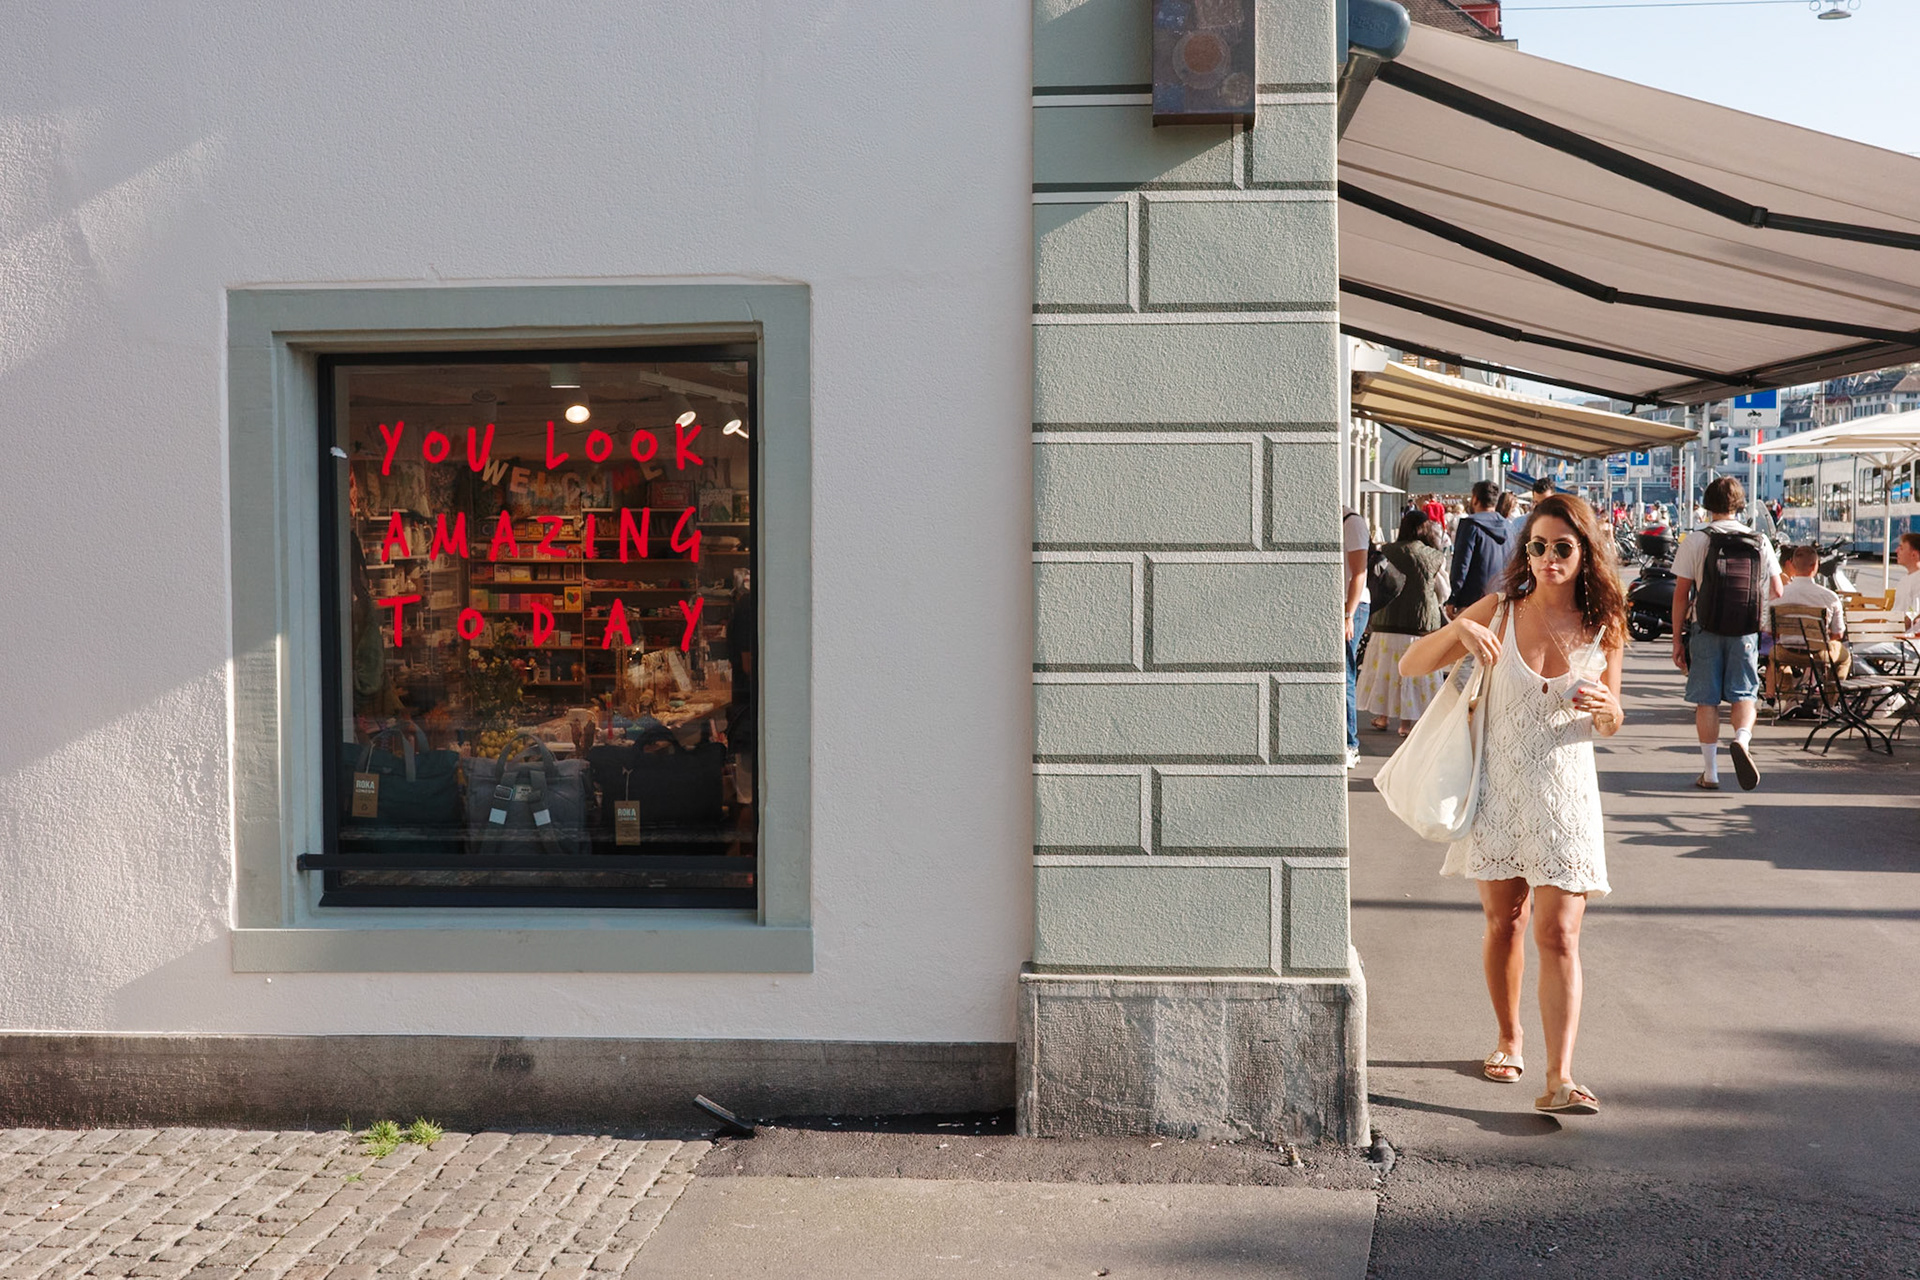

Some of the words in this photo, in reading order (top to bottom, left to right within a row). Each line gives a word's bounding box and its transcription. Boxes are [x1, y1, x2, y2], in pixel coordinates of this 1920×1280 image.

[379, 421, 495, 476] YOU
[546, 421, 704, 470] LOOK
[1635, 452, 1645, 465] P
[1419, 467, 1448, 475] WEEKDAY
[381, 506, 702, 563] AMAZING
[377, 594, 704, 652] TODAY
[356, 780, 375, 789] ROKA
[617, 808, 637, 816] ROKA
